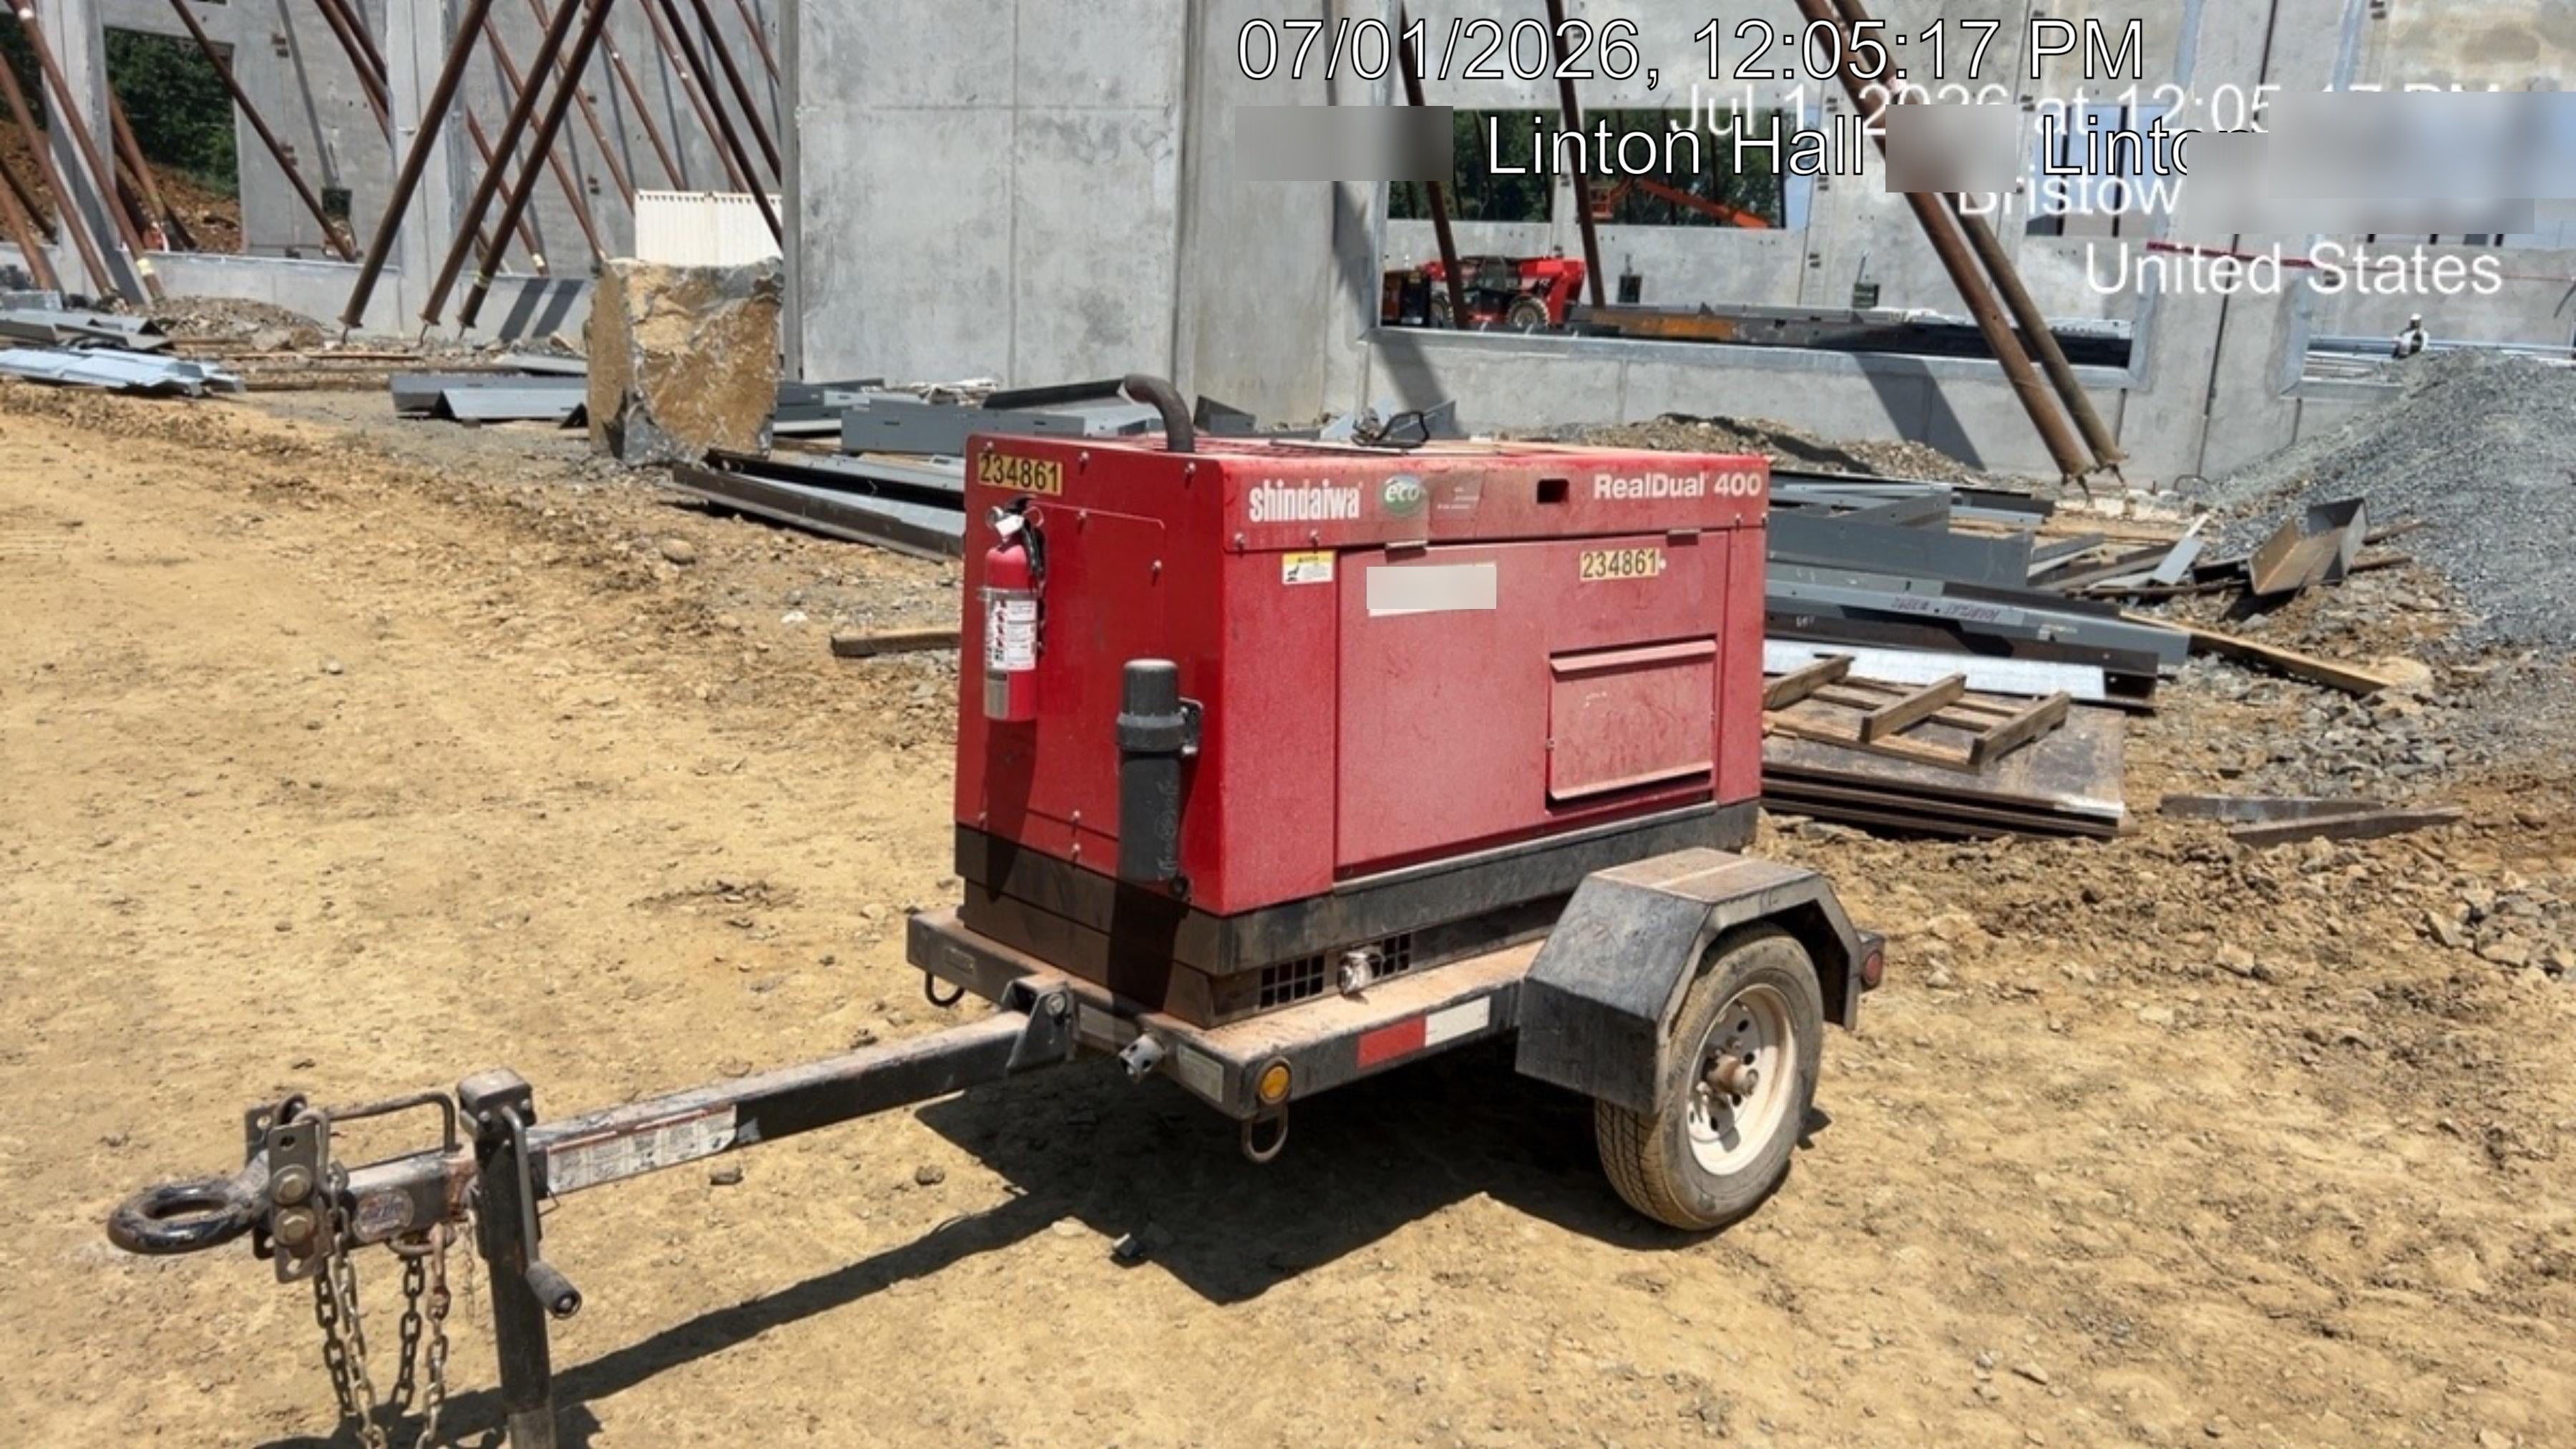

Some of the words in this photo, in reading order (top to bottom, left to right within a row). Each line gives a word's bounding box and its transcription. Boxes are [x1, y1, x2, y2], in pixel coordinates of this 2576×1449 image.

[979, 454, 1058, 494] 234861
[1594, 472, 1706, 499] RealDual
[1713, 472, 1763, 497] 400
[1248, 478, 1360, 523] shindaiwa
[1581, 549, 1656, 578] 234861
